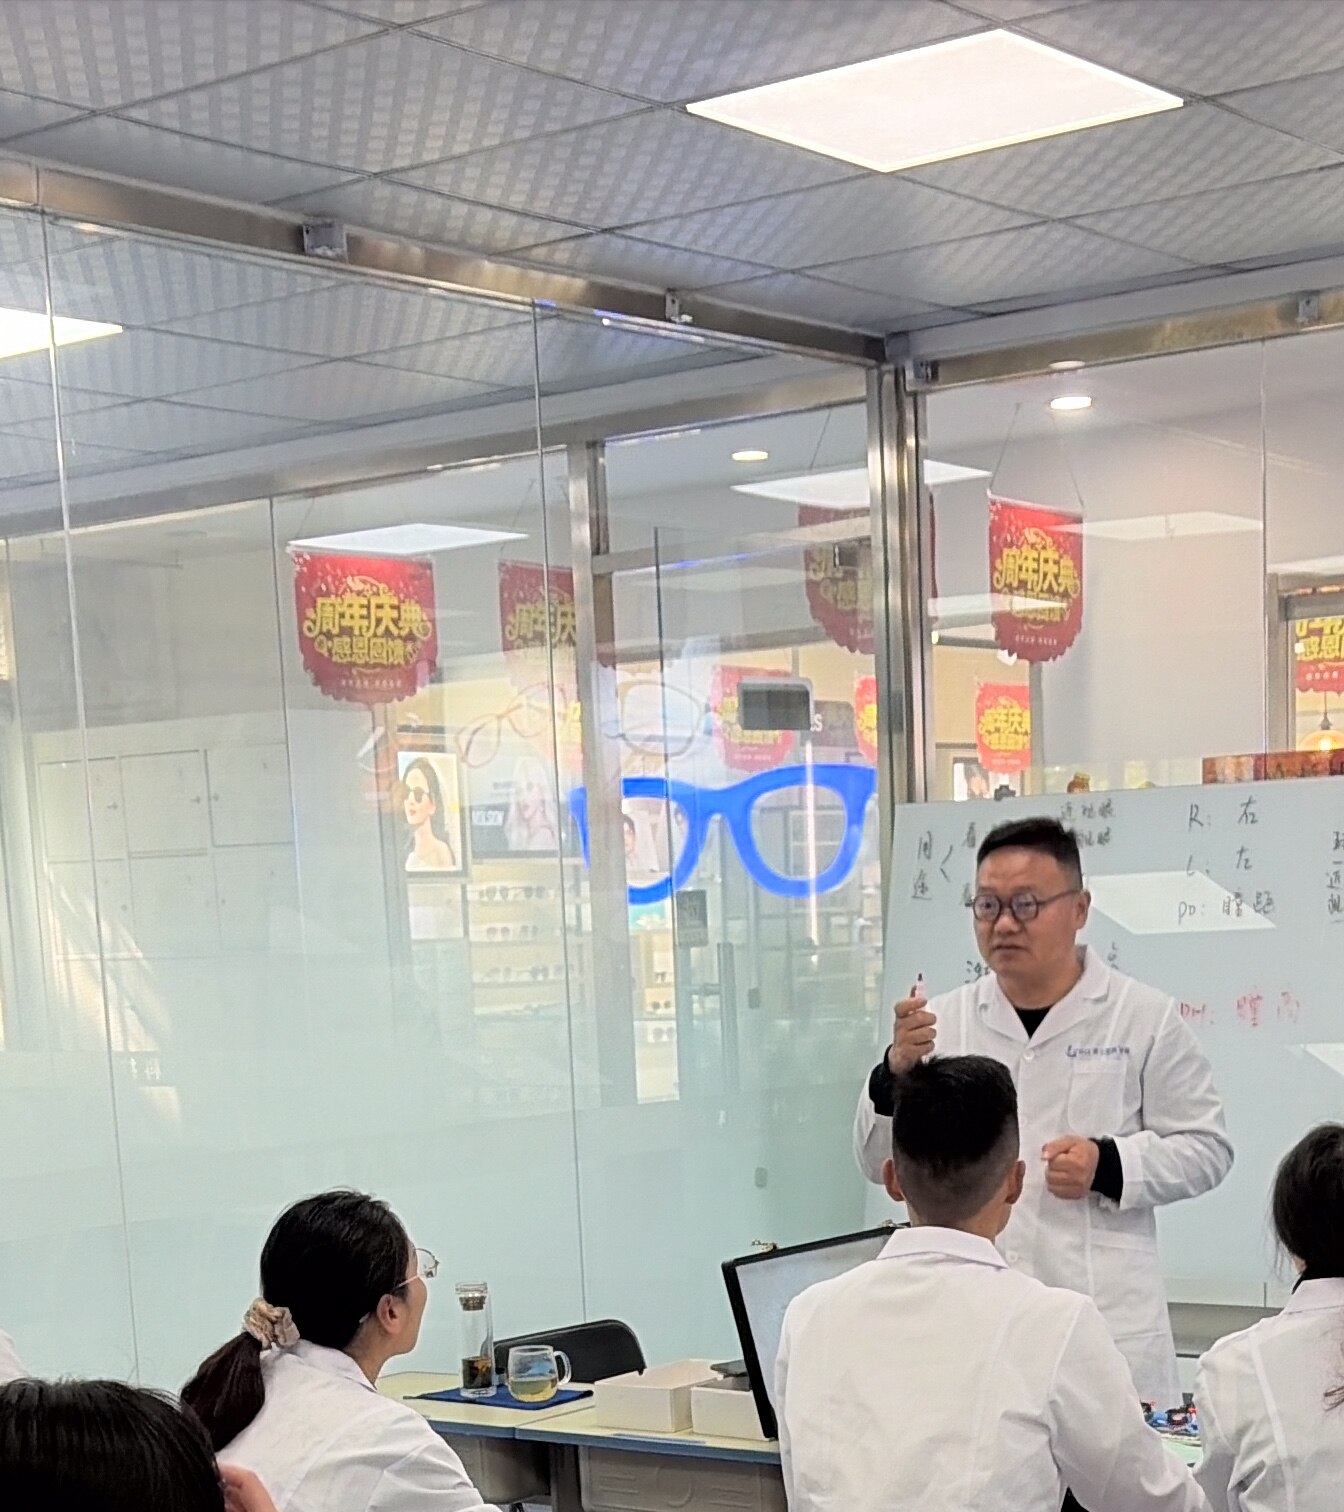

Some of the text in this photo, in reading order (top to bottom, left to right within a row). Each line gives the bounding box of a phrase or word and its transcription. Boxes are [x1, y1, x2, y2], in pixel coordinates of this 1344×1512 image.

[994, 548, 1080, 594] 周年庆典
[304, 590, 432, 640] 周年庆典
[331, 635, 410, 667] 感恩回馈
[1237, 796, 1259, 825] 右
[1235, 845, 1253, 870] 左
